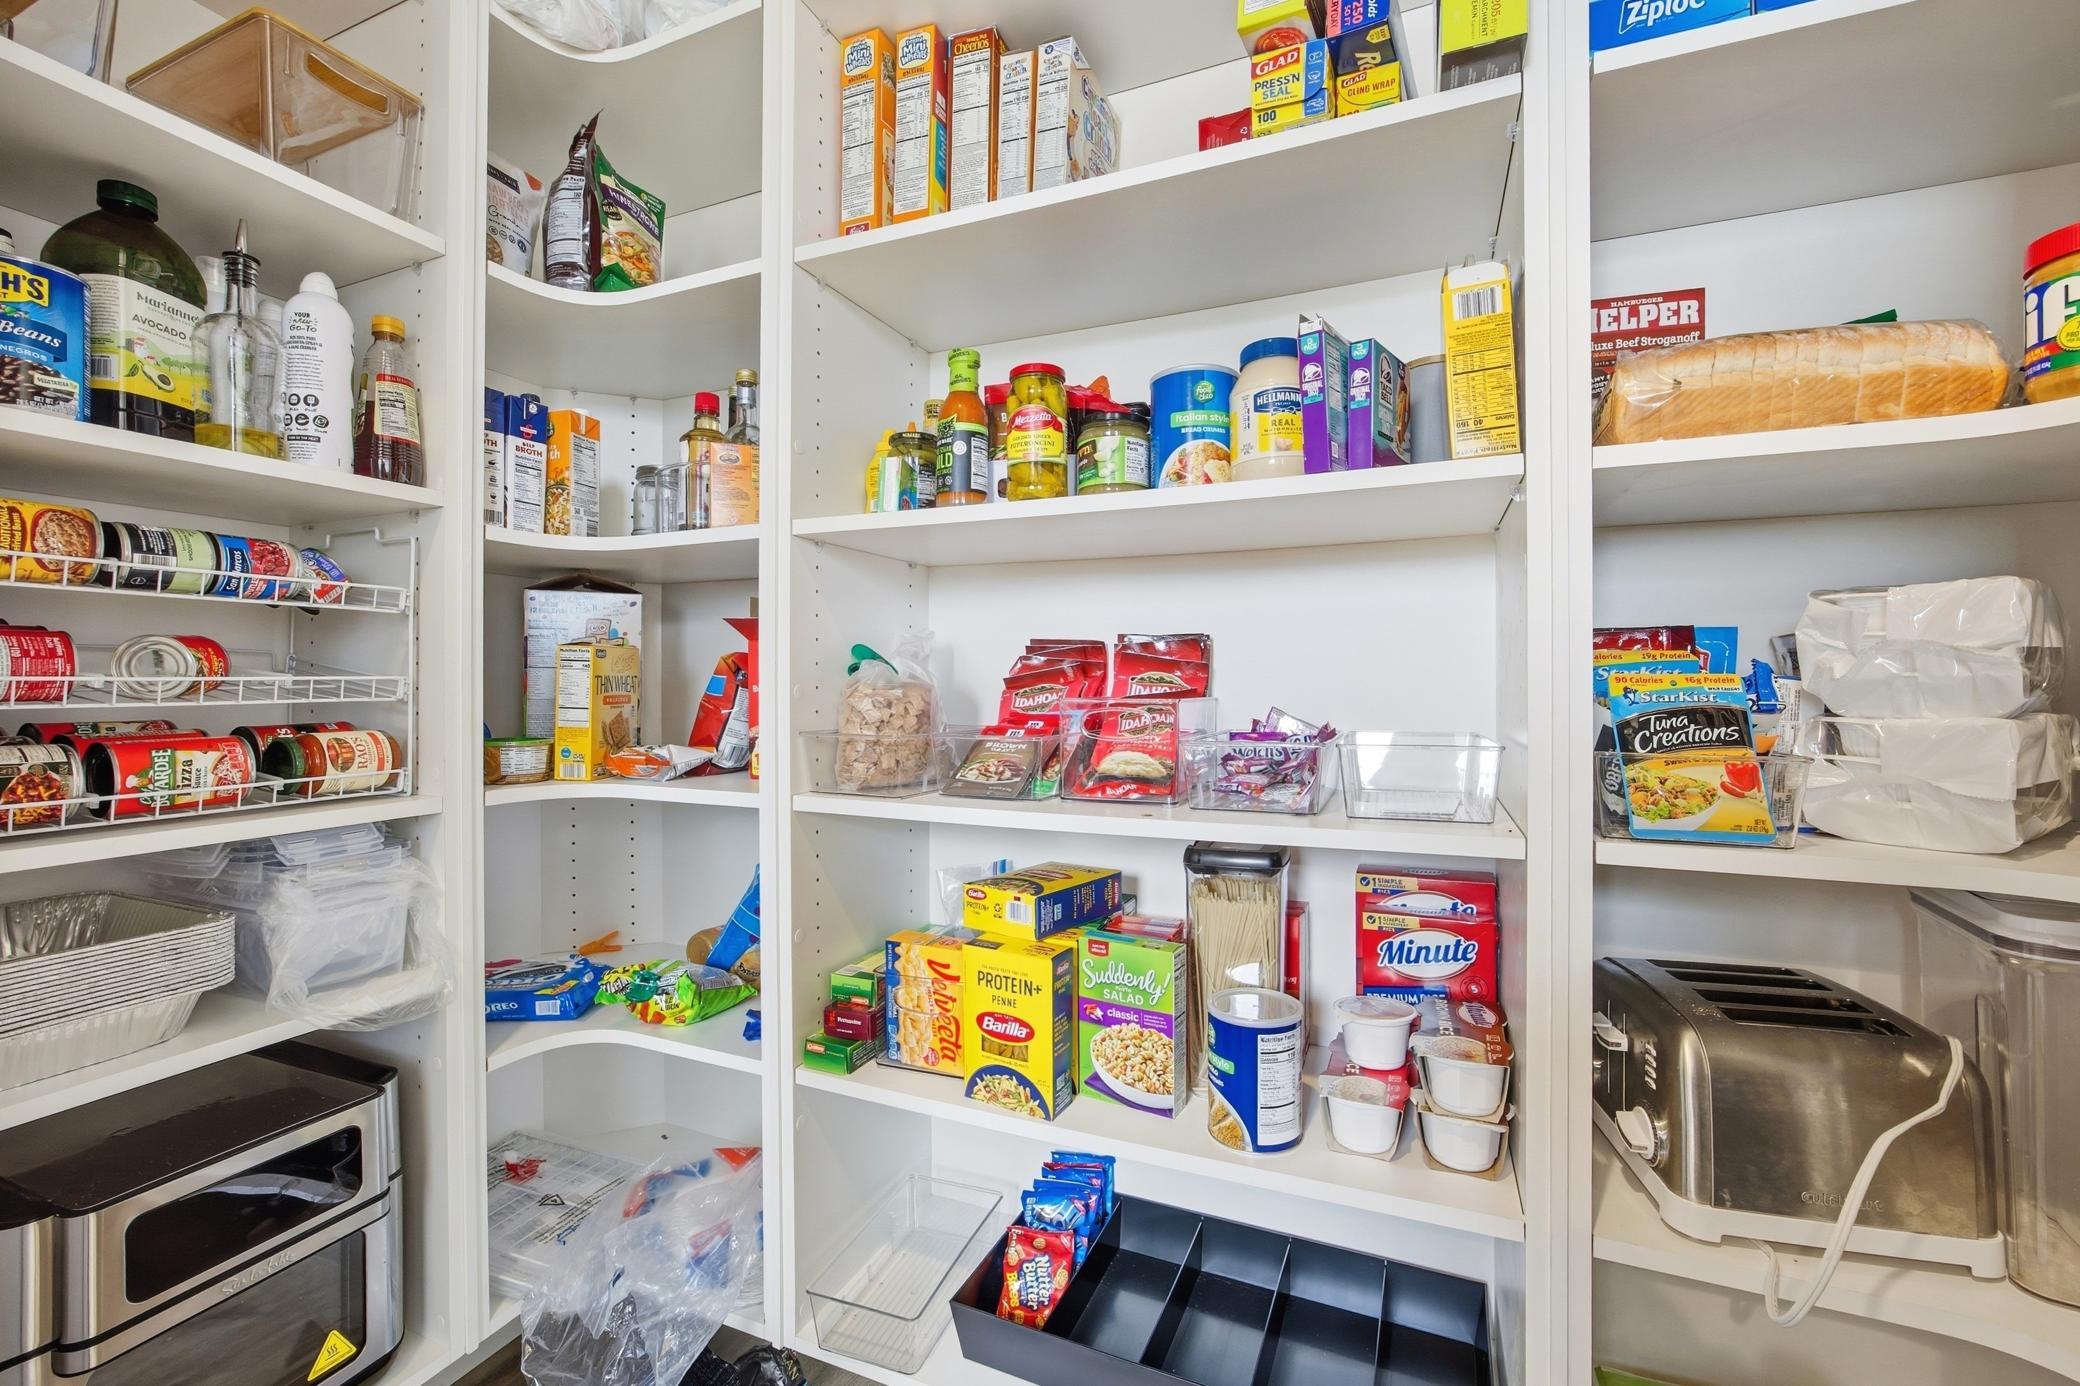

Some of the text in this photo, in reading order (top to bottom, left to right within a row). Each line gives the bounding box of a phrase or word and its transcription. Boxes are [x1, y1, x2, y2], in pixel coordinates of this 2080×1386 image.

[1353, 0, 1363, 24] 250
[902, 40, 927, 55] Mini
[954, 38, 990, 55] Cheerios
[848, 48, 871, 62] Mini
[900, 48, 928, 66] Wheats
[845, 57, 872, 73] Wheats
[1256, 50, 1298, 76] GLAD
[1254, 73, 1300, 91] PRESS'N
[1344, 74, 1366, 87] GLAD
[1347, 78, 1396, 97] CLING WRAP
[1263, 86, 1292, 100] SEAL
[1257, 110, 1277, 124] 100
[1610, 296, 1664, 308] HAMBURGER
[0, 319, 62, 348] Beans
[131, 313, 187, 341] AVOCADO
[289, 324, 318, 333] GO-TO
[1615, 336, 1640, 349] Beef
[1640, 331, 1700, 347] Stroganoff
[0, 344, 48, 362] NEGROS
[1380, 381, 1393, 395] TACO
[1381, 392, 1393, 406] BELL
[1012, 413, 1053, 428] Mezzetta
[1176, 412, 1230, 424] Italian style
[1271, 419, 1296, 427] REAL
[1203, 426, 1226, 434] CRUMBS
[515, 445, 543, 458] BROTH
[226, 550, 242, 590] San arcos
[1641, 652, 1657, 661] 19g
[1659, 652, 1691, 660] Protein
[595, 675, 614, 697] THIN
[1629, 676, 1663, 684] Calories
[1685, 677, 1702, 686] 16g
[1703, 676, 1735, 684] Protein
[1640, 691, 1718, 703] StarKist
[1121, 713, 1175, 731] IDAHOAN
[1639, 713, 1689, 733] Tuna
[353, 735, 368, 770] RAO'S
[985, 742, 1028, 750] BROWN
[1106, 784, 1137, 795] IDAHOAN
[967, 889, 986, 898] Barilla
[966, 902, 989, 912] PROTEIN+
[1379, 938, 1477, 967] Minute
[977, 971, 1042, 997] PROTEIN+
[1082, 958, 1171, 1006] Suddenly!
[1471, 985, 1478, 993] 5
[992, 995, 1017, 1009] PENNE
[1103, 989, 1144, 1006] SALAD
[927, 959, 962, 1063] Velveeta
[1107, 1008, 1139, 1022] classic
[982, 1016, 1028, 1039] Barilla
[1022, 1261, 1038, 1311] Butter
[1034, 1255, 1050, 1306] Nutter
